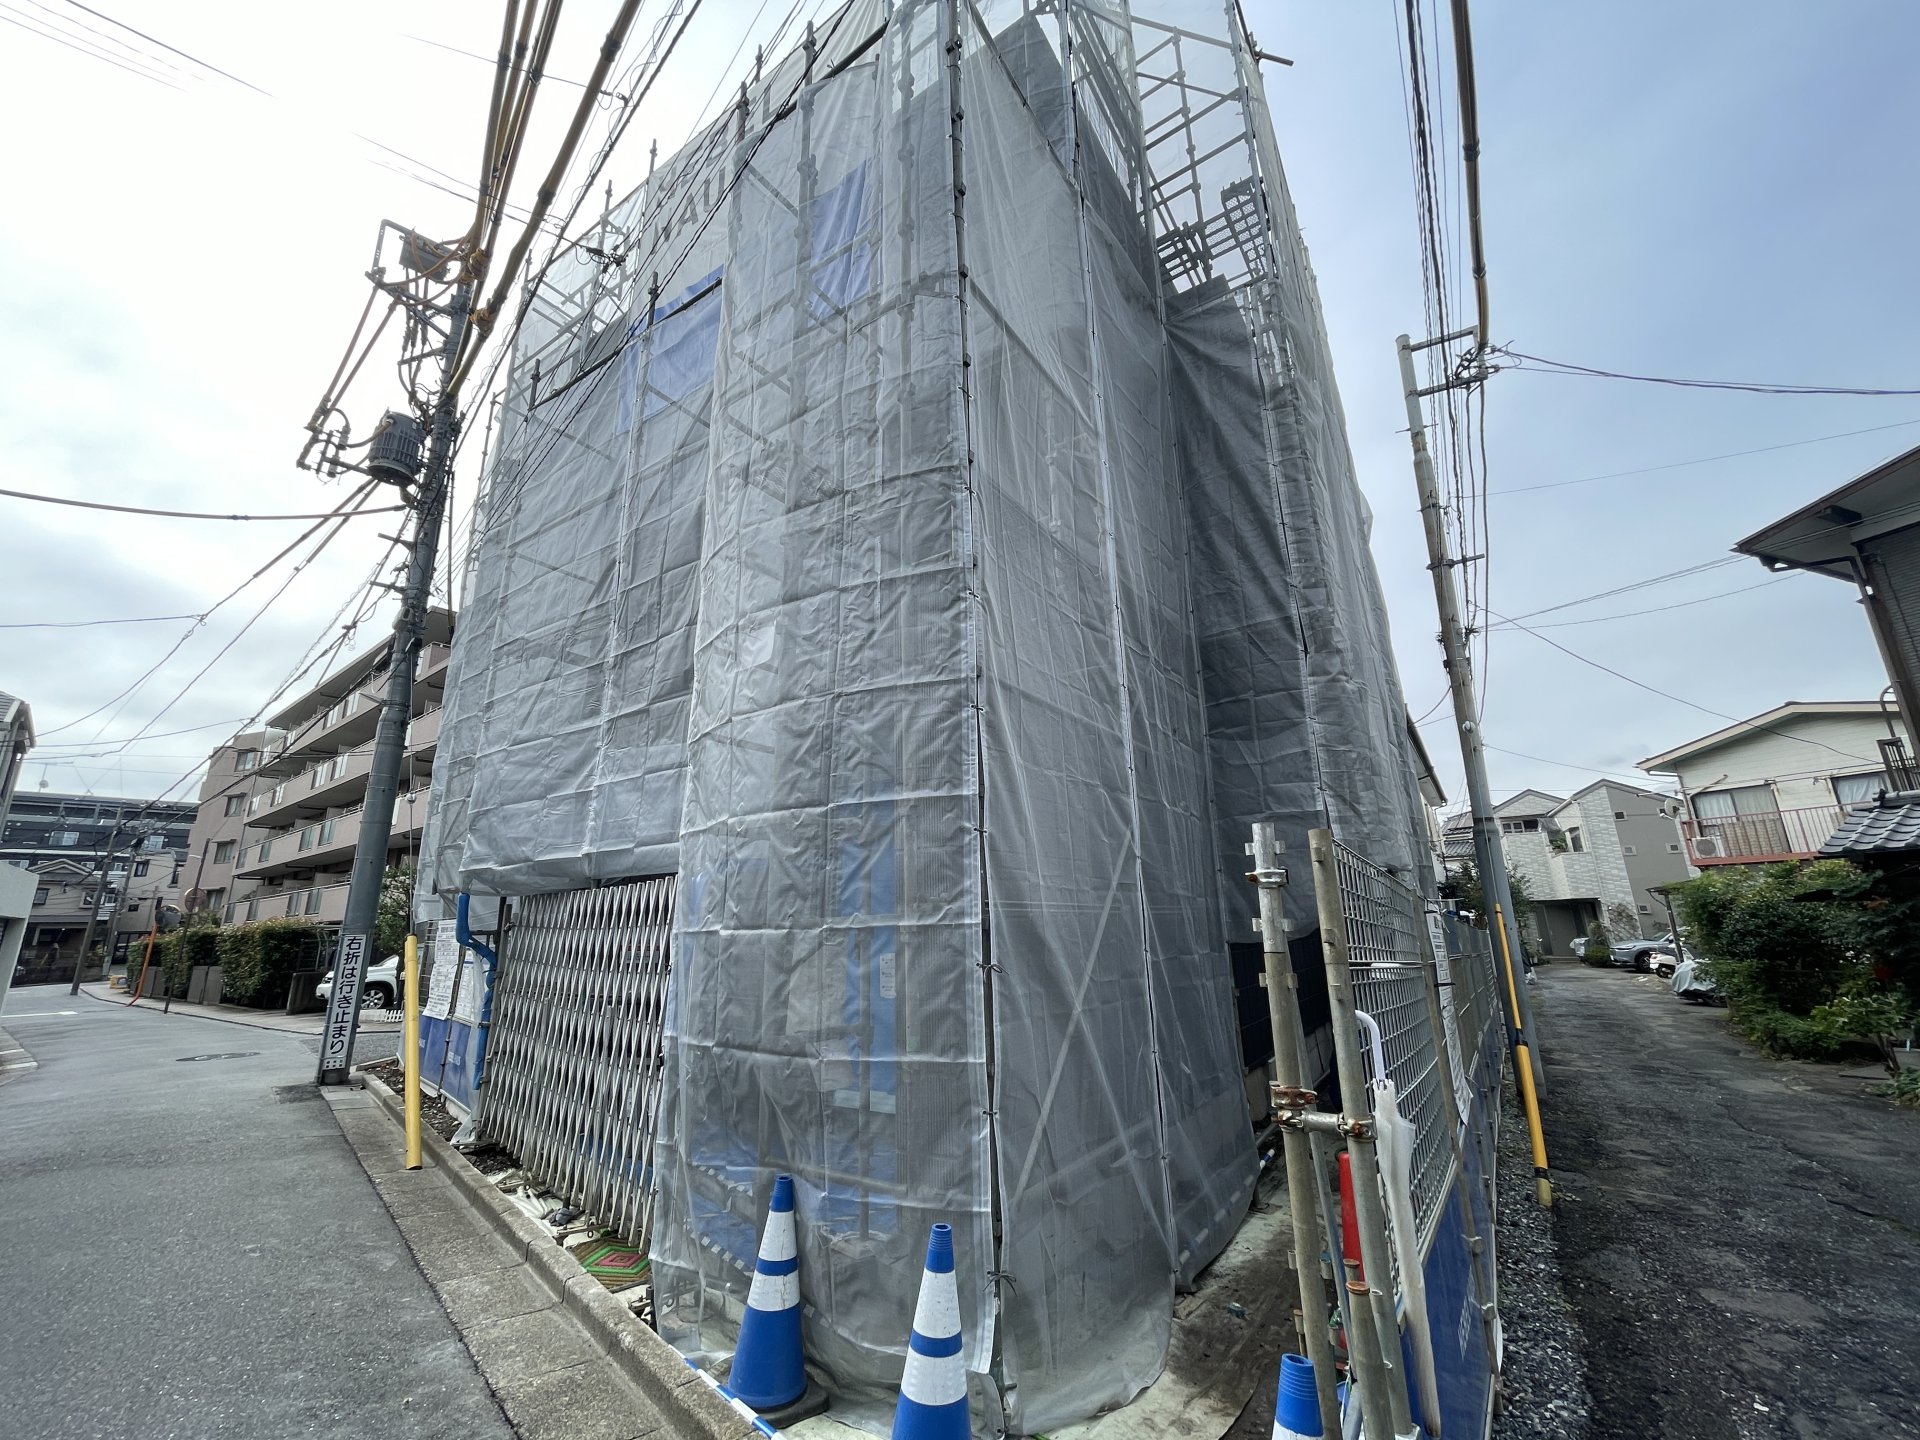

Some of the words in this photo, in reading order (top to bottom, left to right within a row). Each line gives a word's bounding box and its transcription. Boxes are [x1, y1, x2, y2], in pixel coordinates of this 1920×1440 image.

[329, 936, 362, 1055] 右折は行き止まり
